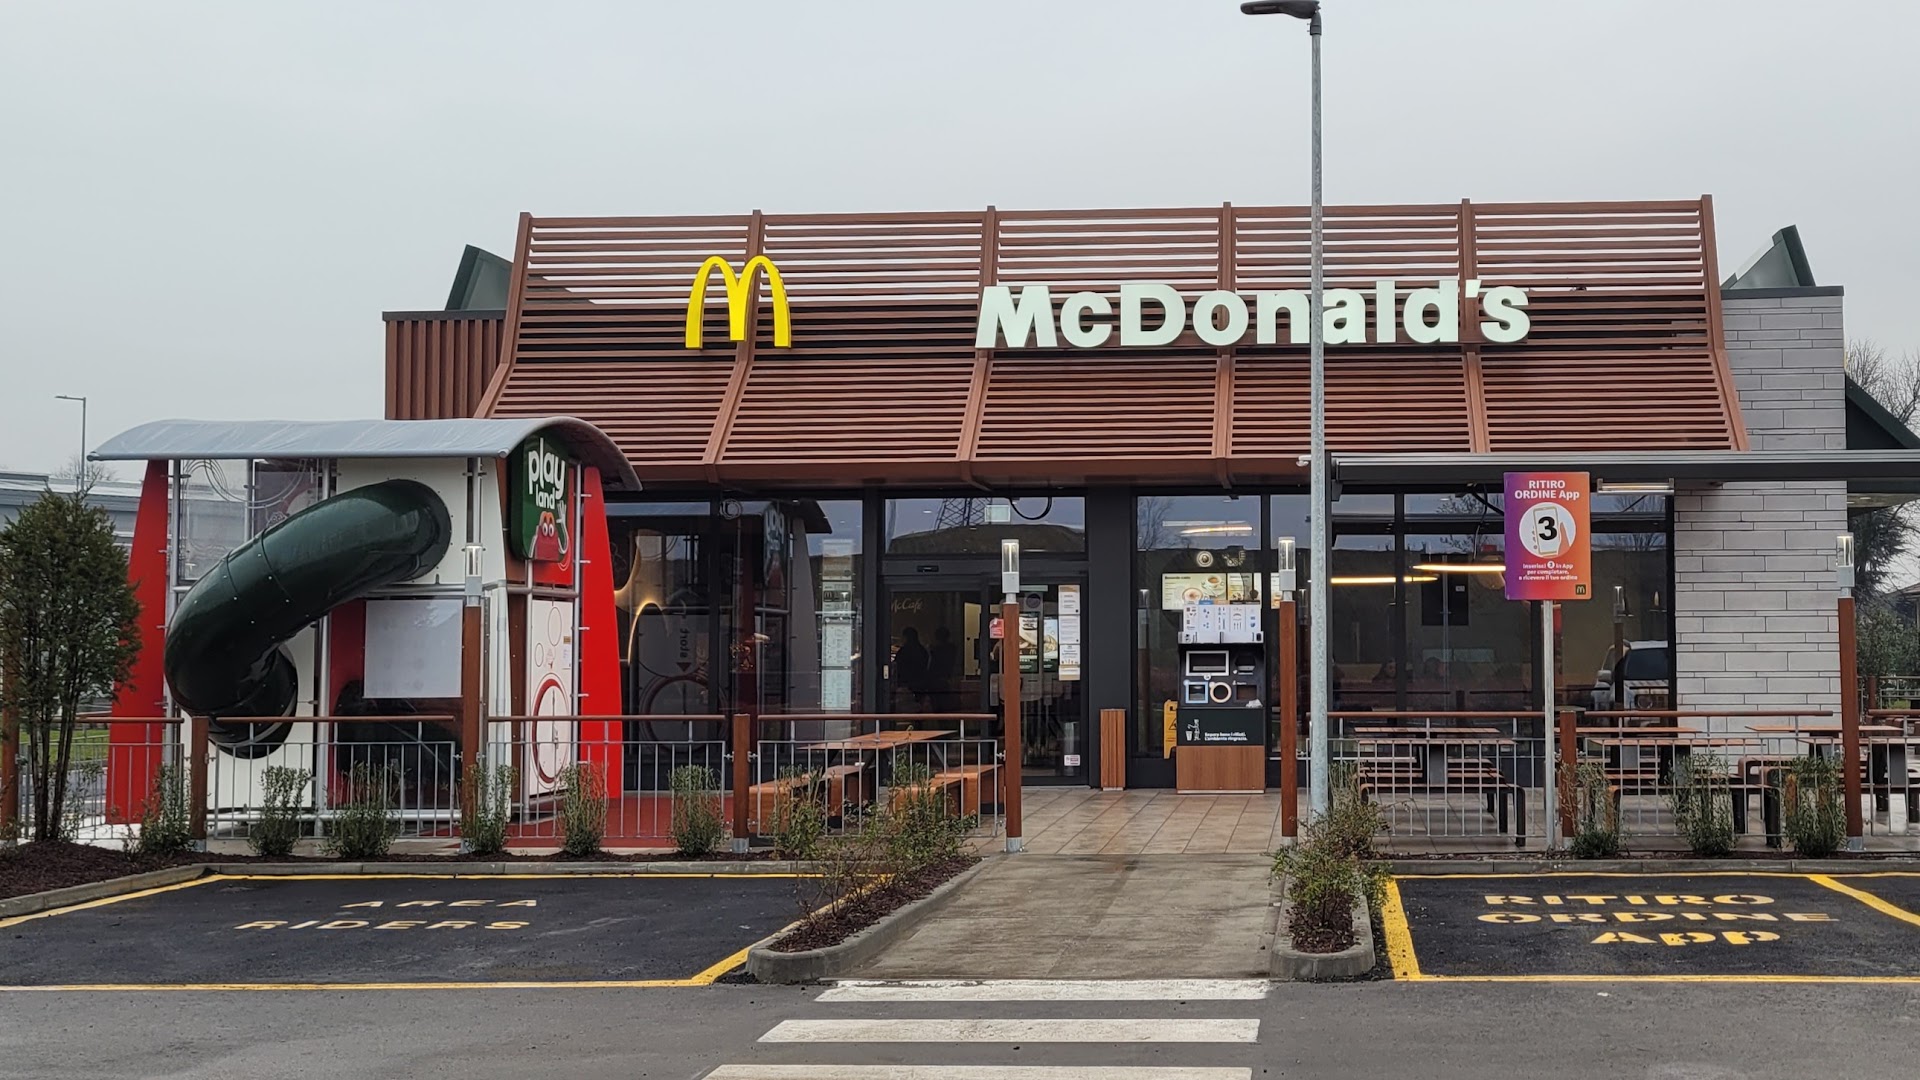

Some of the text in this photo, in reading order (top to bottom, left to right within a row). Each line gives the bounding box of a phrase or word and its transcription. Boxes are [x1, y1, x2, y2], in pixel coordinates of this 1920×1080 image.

[975, 279, 1531, 350] McDonald's
[528, 437, 566, 500] play
[1528, 480, 1566, 489] RITIRO
[535, 483, 556, 510] land
[1514, 490, 1580, 501] ORDINE App
[1538, 516, 1558, 541] 3
[340, 899, 537, 908] AREA
[1484, 894, 1776, 905] RITIRO
[1477, 911, 1840, 924] ORDINE
[233, 920, 531, 930] RIDERS
